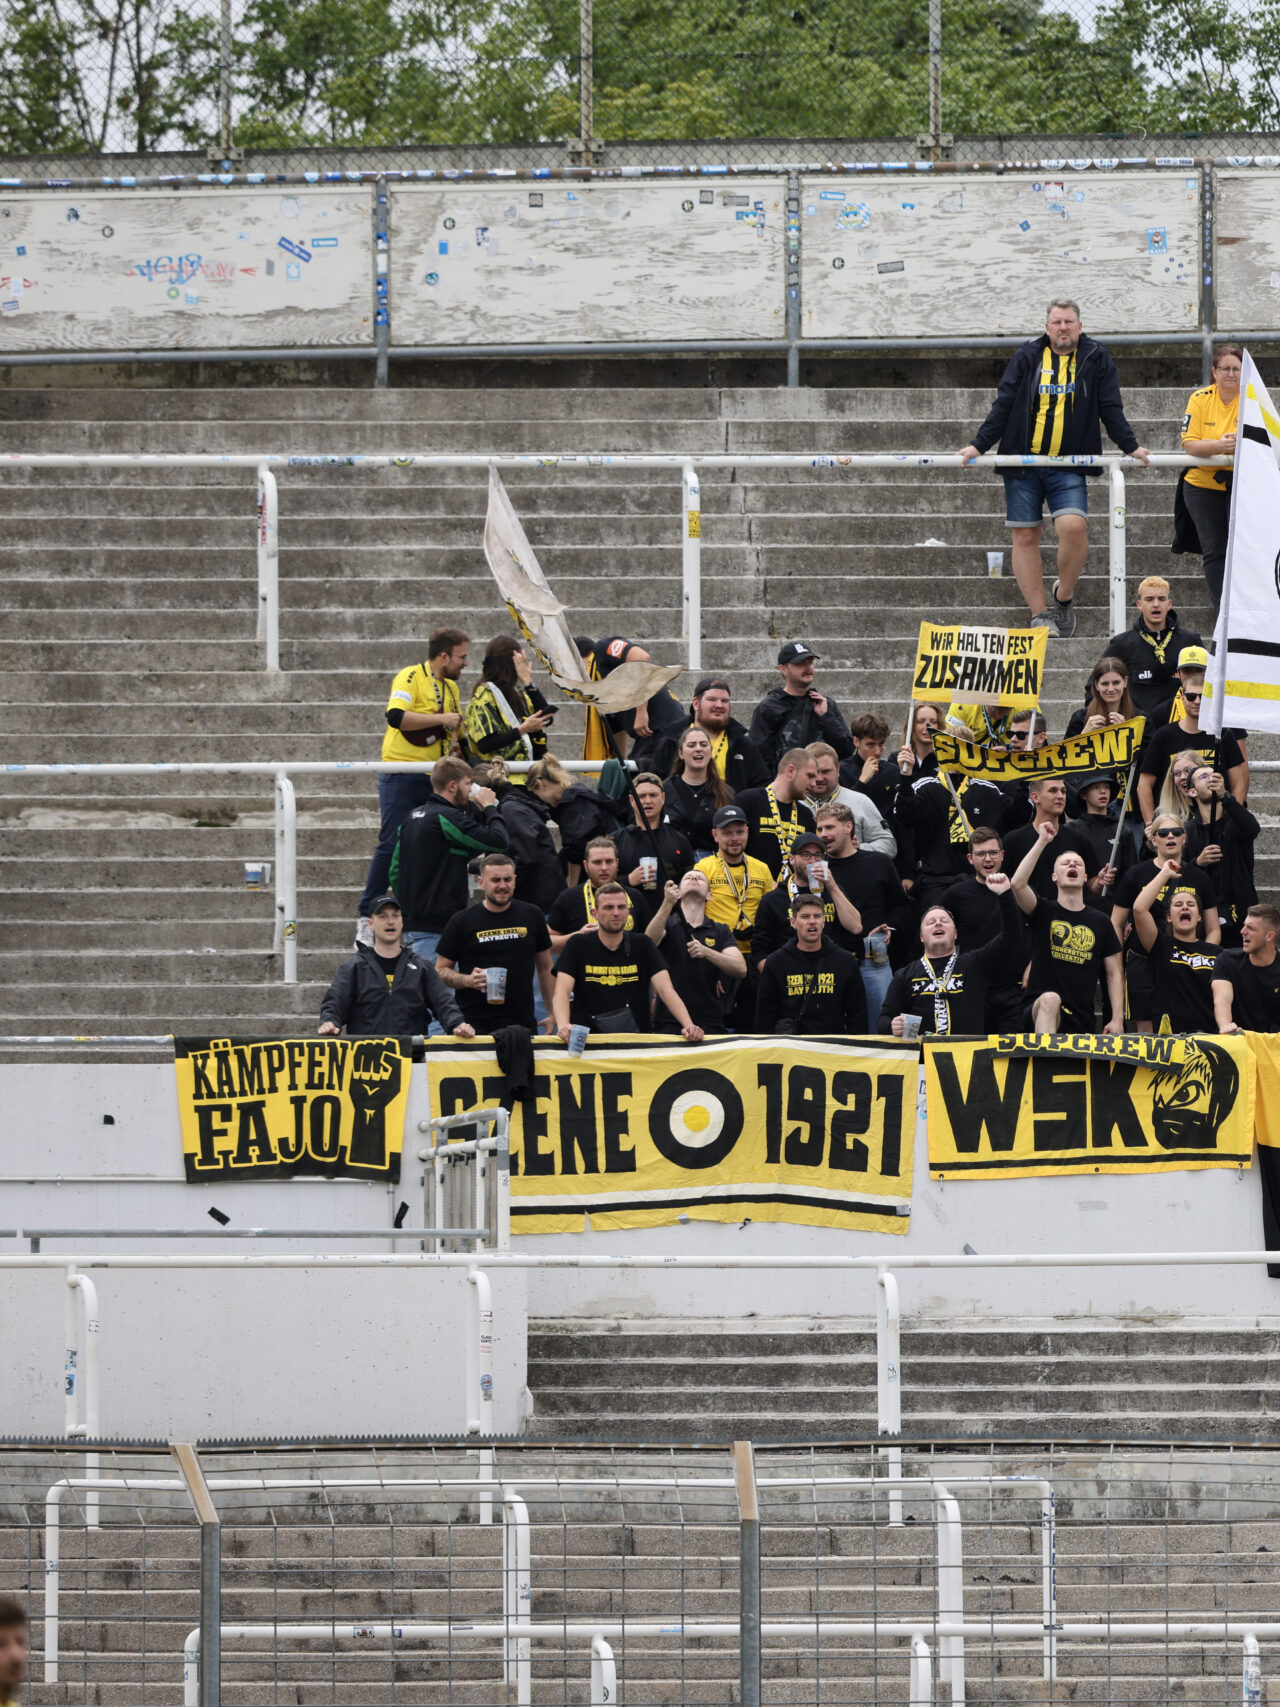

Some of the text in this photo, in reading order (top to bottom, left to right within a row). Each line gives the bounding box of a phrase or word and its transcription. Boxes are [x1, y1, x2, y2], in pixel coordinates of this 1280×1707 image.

[957, 632, 1005, 655] HALTEN
[1007, 635, 1034, 655] FEST
[915, 654, 1038, 695] ZUSAMMEN
[932, 727, 1134, 774] SUPCREW
[479, 933, 519, 943] BAYREUTH
[818, 973, 835, 984] 1921
[191, 1039, 349, 1100] KÄMPFEN
[997, 1031, 1177, 1064] SUPCREW
[757, 1063, 905, 1178] 1921
[933, 1050, 1149, 1154] WSK
[195, 1094, 342, 1168] FAJO
